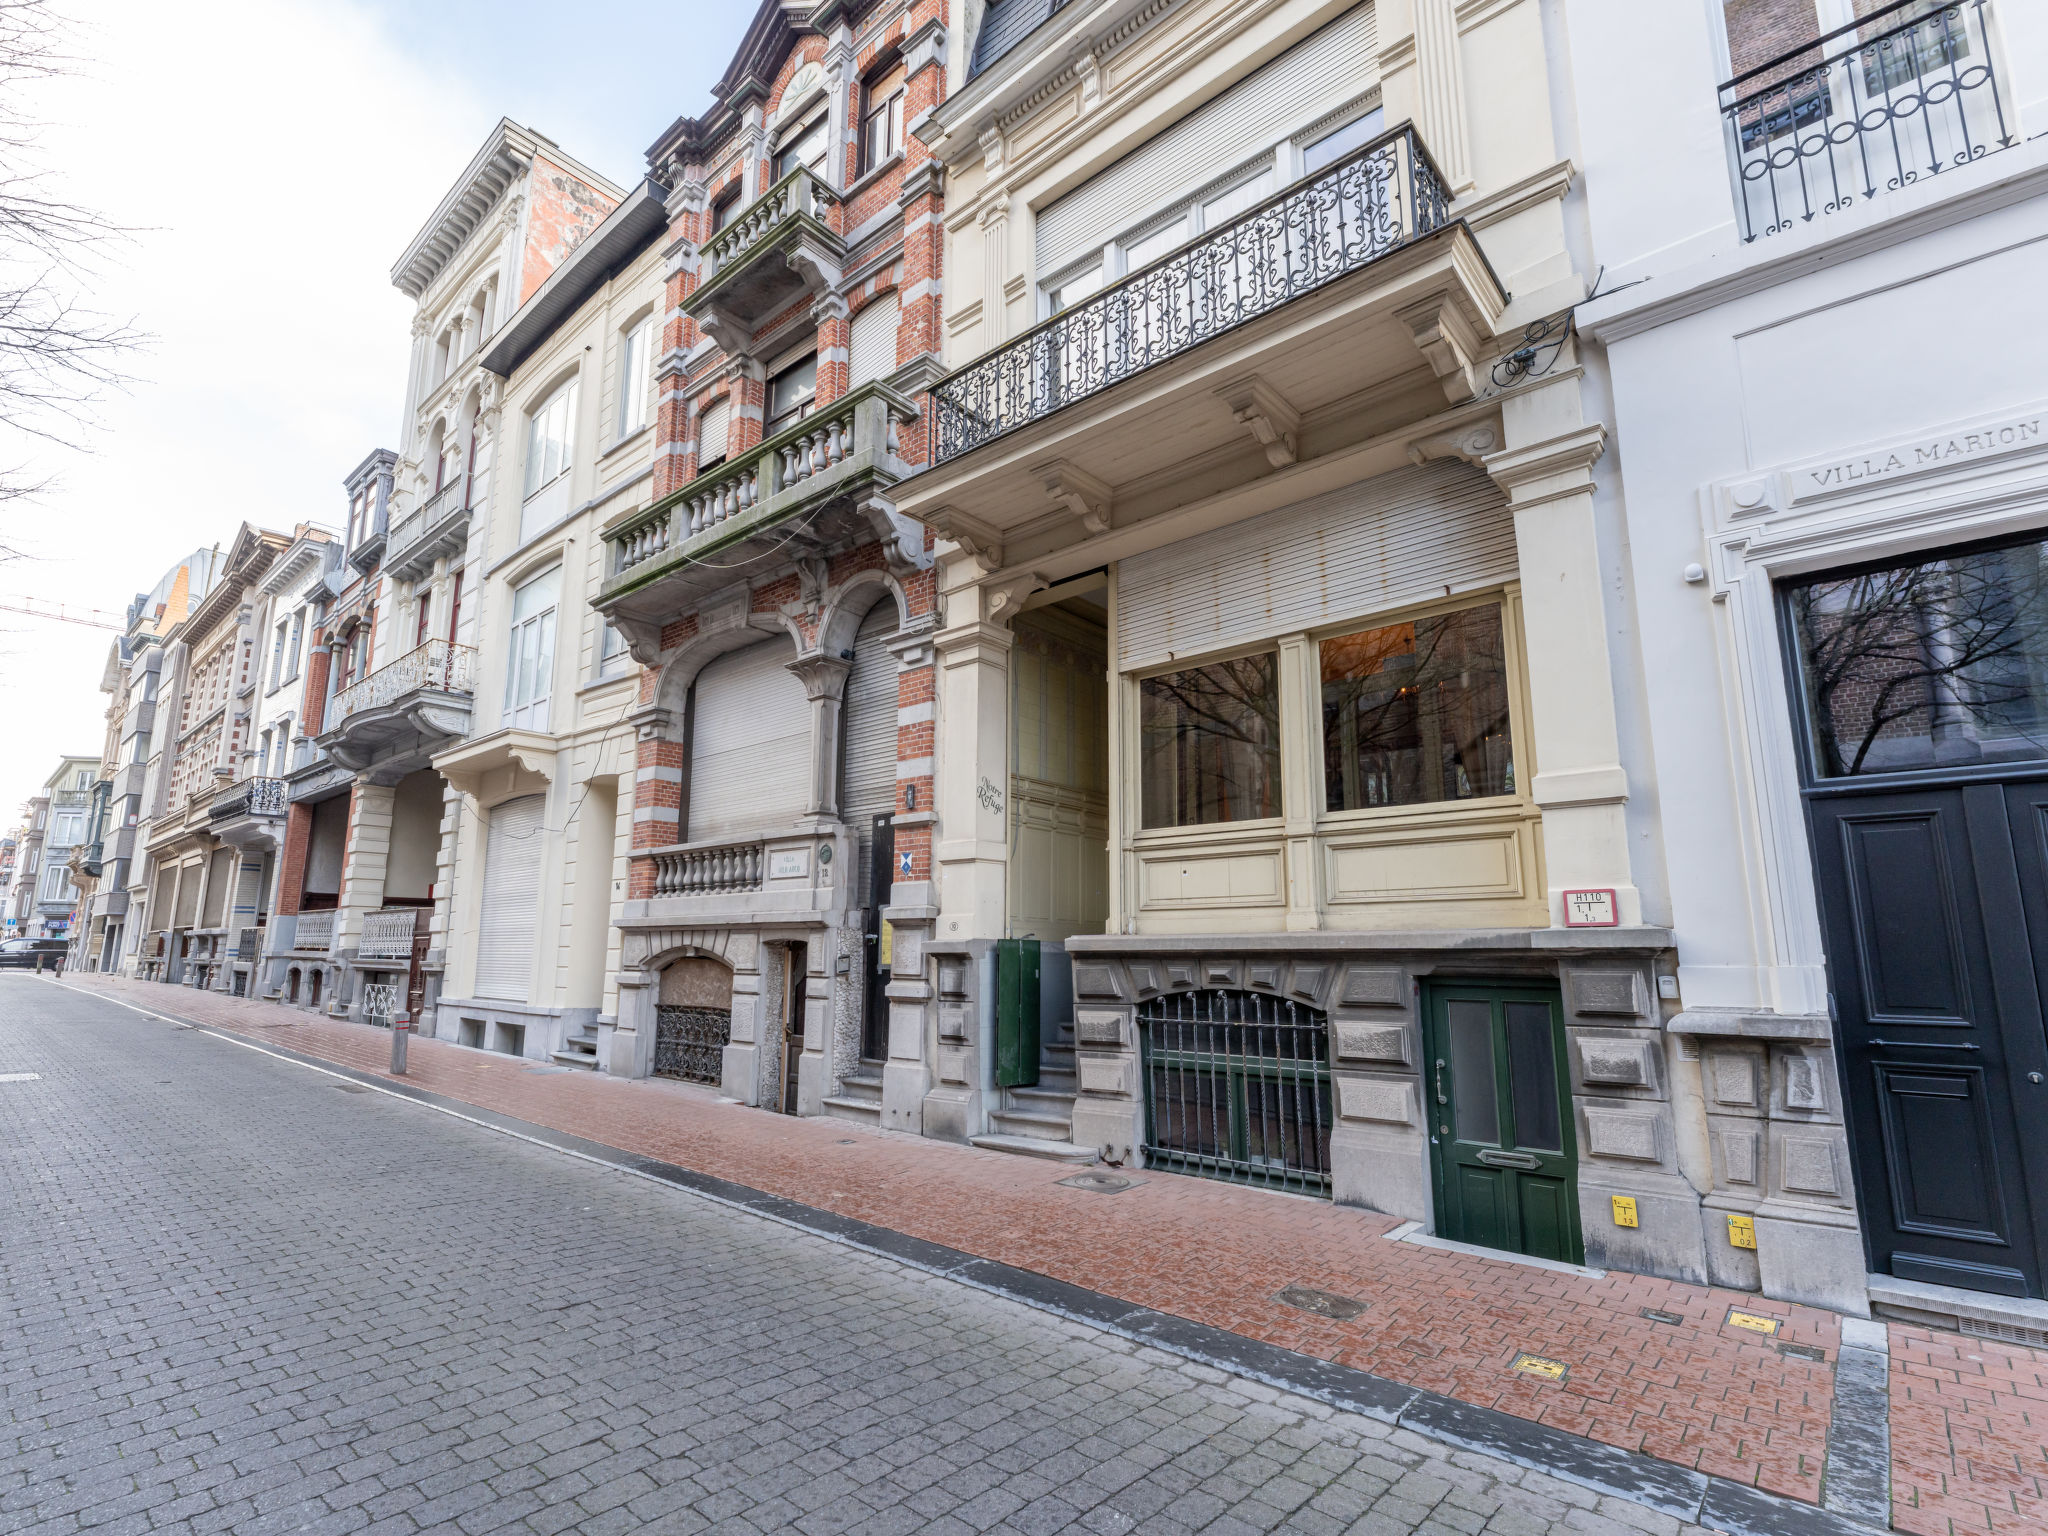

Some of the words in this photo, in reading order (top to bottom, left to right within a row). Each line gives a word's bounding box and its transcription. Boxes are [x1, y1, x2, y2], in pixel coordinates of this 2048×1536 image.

[1811, 454, 1905, 486] VILLA
[1914, 420, 2041, 465] MARION
[982, 776, 1002, 797] Notre
[977, 786, 1003, 815] Refuge
[1576, 893, 1602, 902] H110
